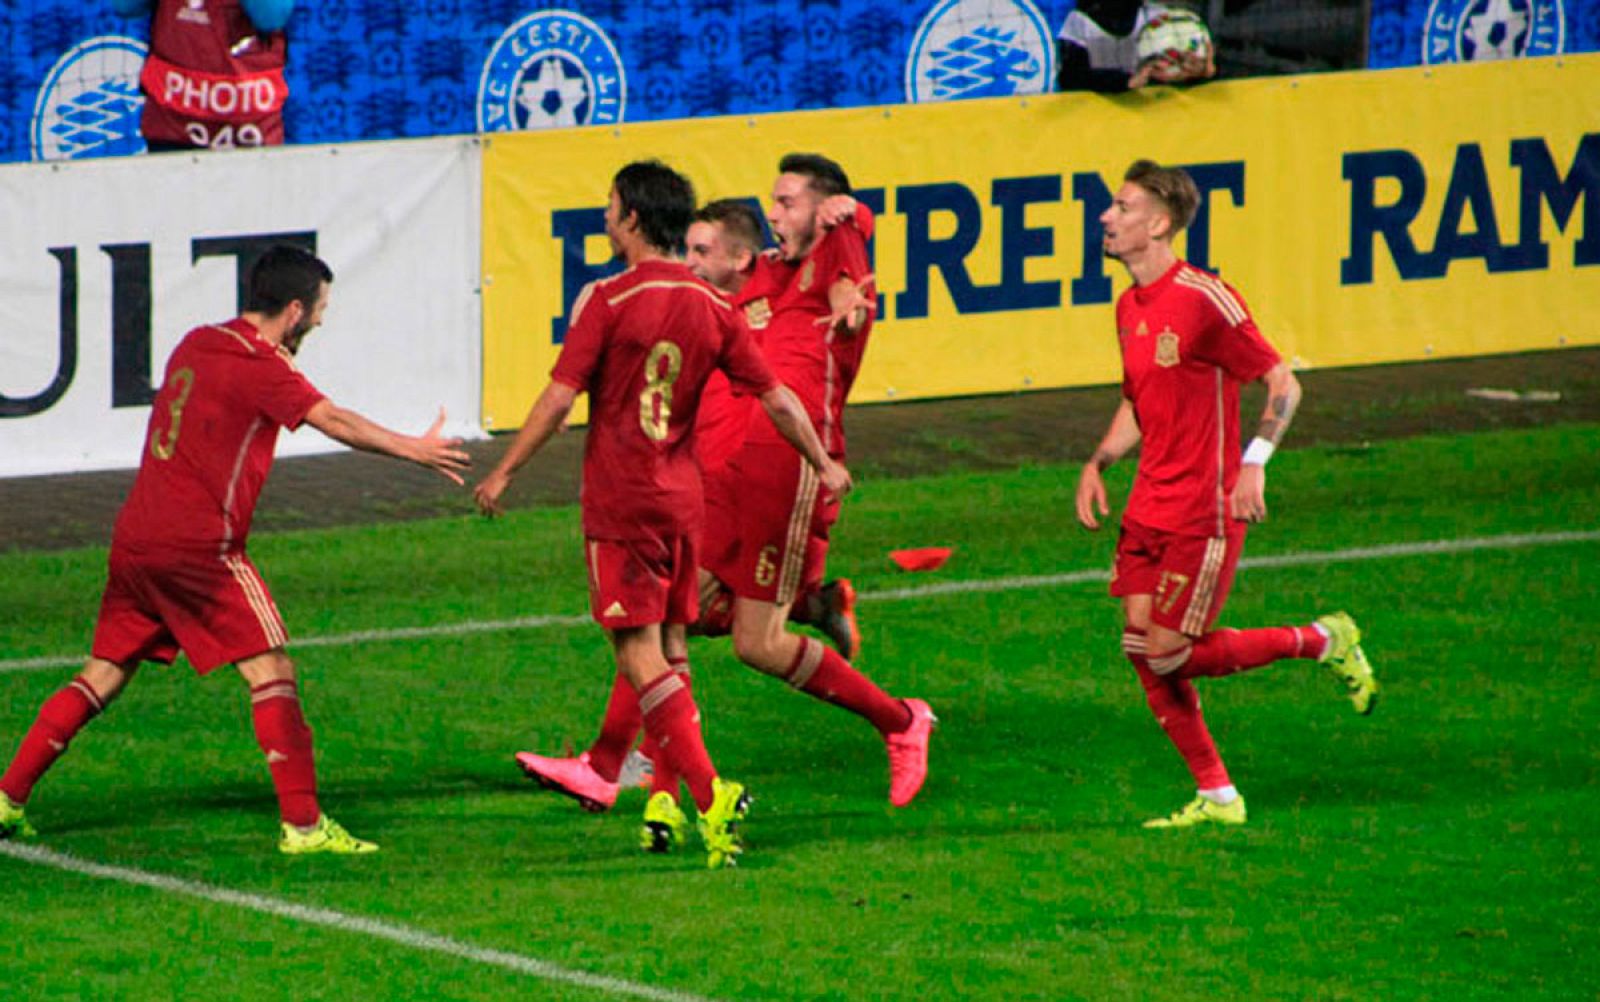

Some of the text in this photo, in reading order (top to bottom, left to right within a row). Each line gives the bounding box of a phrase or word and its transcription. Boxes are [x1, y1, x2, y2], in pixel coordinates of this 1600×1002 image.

[164, 71, 276, 114] PHOTO
[1340, 131, 1600, 286] RAM
[151, 367, 195, 461] 3
[639, 341, 683, 441] 8
[755, 544, 779, 587] 6
